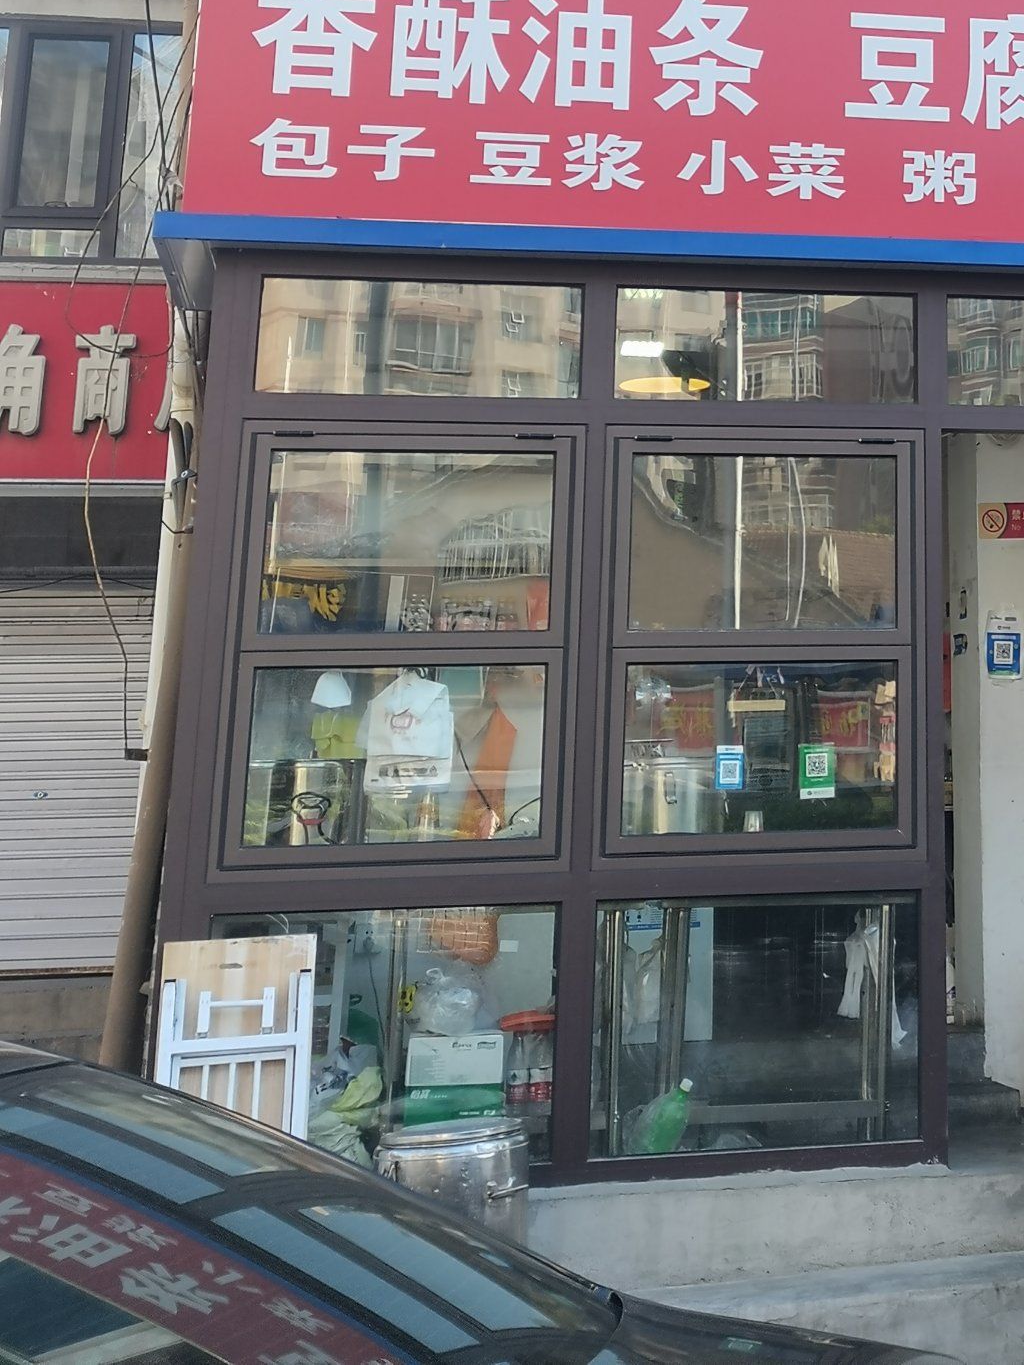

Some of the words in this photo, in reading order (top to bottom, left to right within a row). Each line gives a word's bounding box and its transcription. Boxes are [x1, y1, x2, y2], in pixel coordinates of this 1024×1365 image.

[250, 118, 435, 181] 包子
[470, 132, 644, 190] 豆浆
[677, 140, 845, 199] 小菜
[903, 150, 976, 205] 粥
[0, 323, 172, 435] 角商
